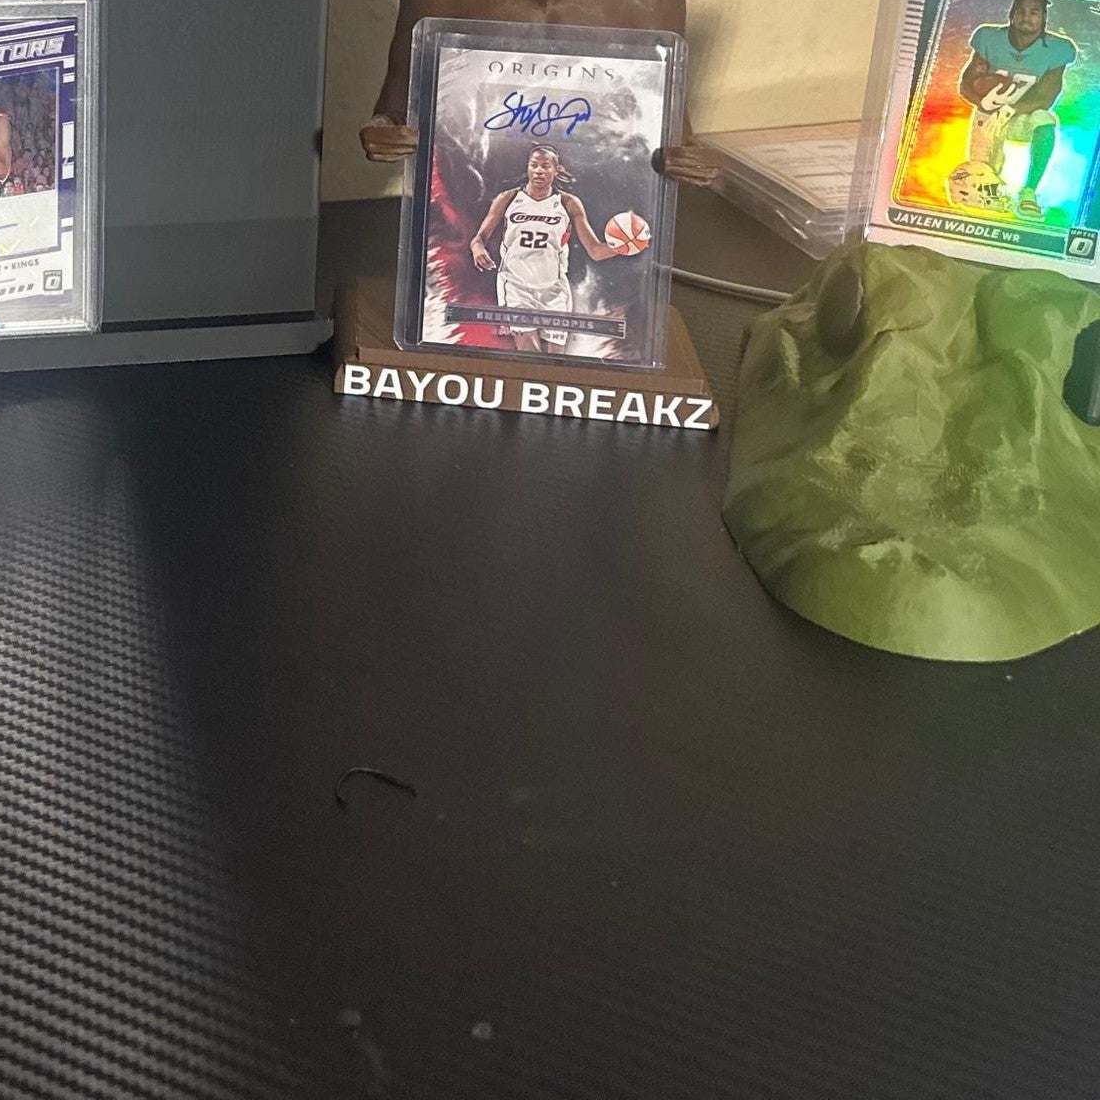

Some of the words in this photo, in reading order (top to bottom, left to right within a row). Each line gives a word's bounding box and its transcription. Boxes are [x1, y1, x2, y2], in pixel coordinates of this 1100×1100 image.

[488, 60, 616, 81] ORIGINS
[893, 211, 943, 230] JAYLEN
[944, 219, 1001, 240] WADDLE
[1002, 231, 1020, 243] WR
[519, 230, 549, 249] 22
[11, 258, 40, 270] KINGS
[343, 364, 504, 409] BAYOU
[520, 382, 713, 430] BREAKZ
